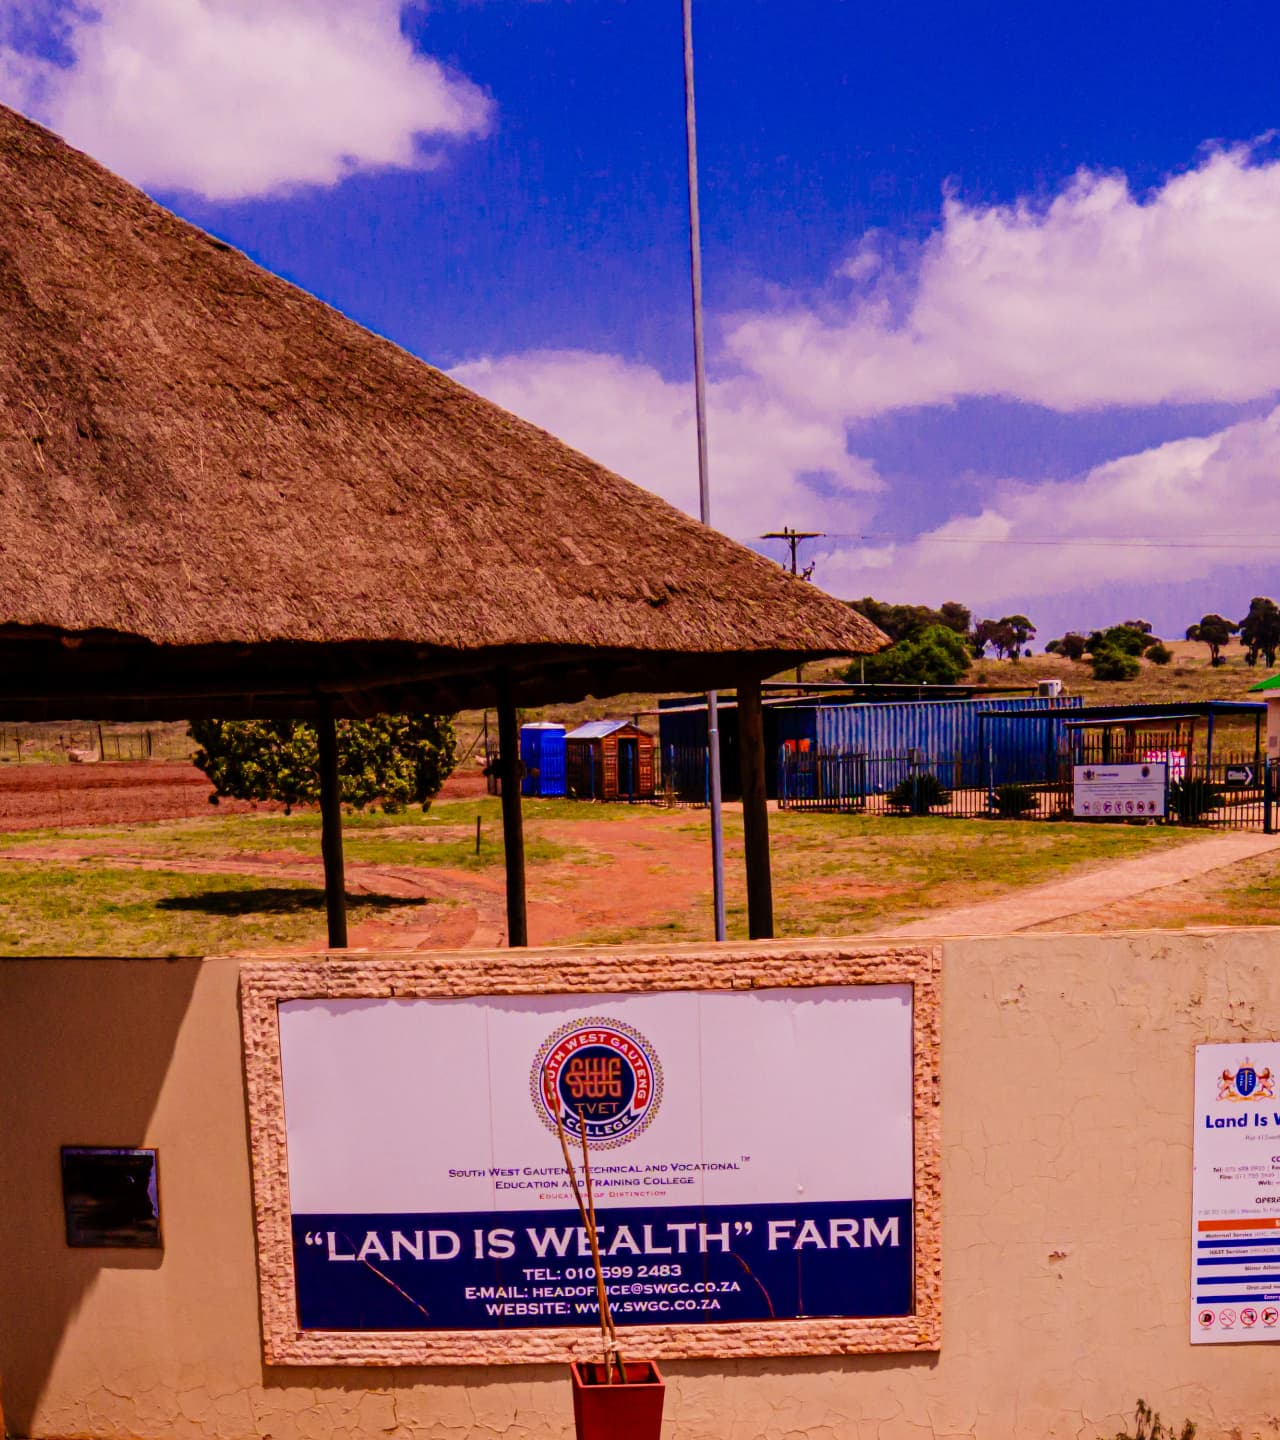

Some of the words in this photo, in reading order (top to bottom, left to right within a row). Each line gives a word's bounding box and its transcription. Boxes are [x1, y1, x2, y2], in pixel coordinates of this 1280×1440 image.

[565, 1033, 607, 1050] WEST
[610, 1037, 648, 1100] GAUTENG
[574, 1102, 620, 1114] TVET
[1205, 1113, 1247, 1128] Land
[1254, 1113, 1267, 1126] Is
[449, 1169, 485, 1178] SOUTH
[488, 1168, 520, 1177] WEST
[578, 1165, 643, 1174] TECHNICAL
[645, 1164, 667, 1172] AND
[670, 1163, 740, 1171] VOCATIONAL
[495, 1180, 558, 1189] EDUCATION
[643, 1177, 695, 1185] COLLEGE
[305, 1229, 461, 1262] “LAND
[474, 1229, 516, 1260] IS
[768, 1216, 900, 1251] FARM
[523, 1268, 561, 1280] TEL:
[565, 1267, 596, 1280] 010
[600, 1266, 633, 1279] 599
[637, 1265, 682, 1278] 2483
[465, 1286, 528, 1299] E-MAIL:
[486, 1302, 570, 1316] WEBSITE:
